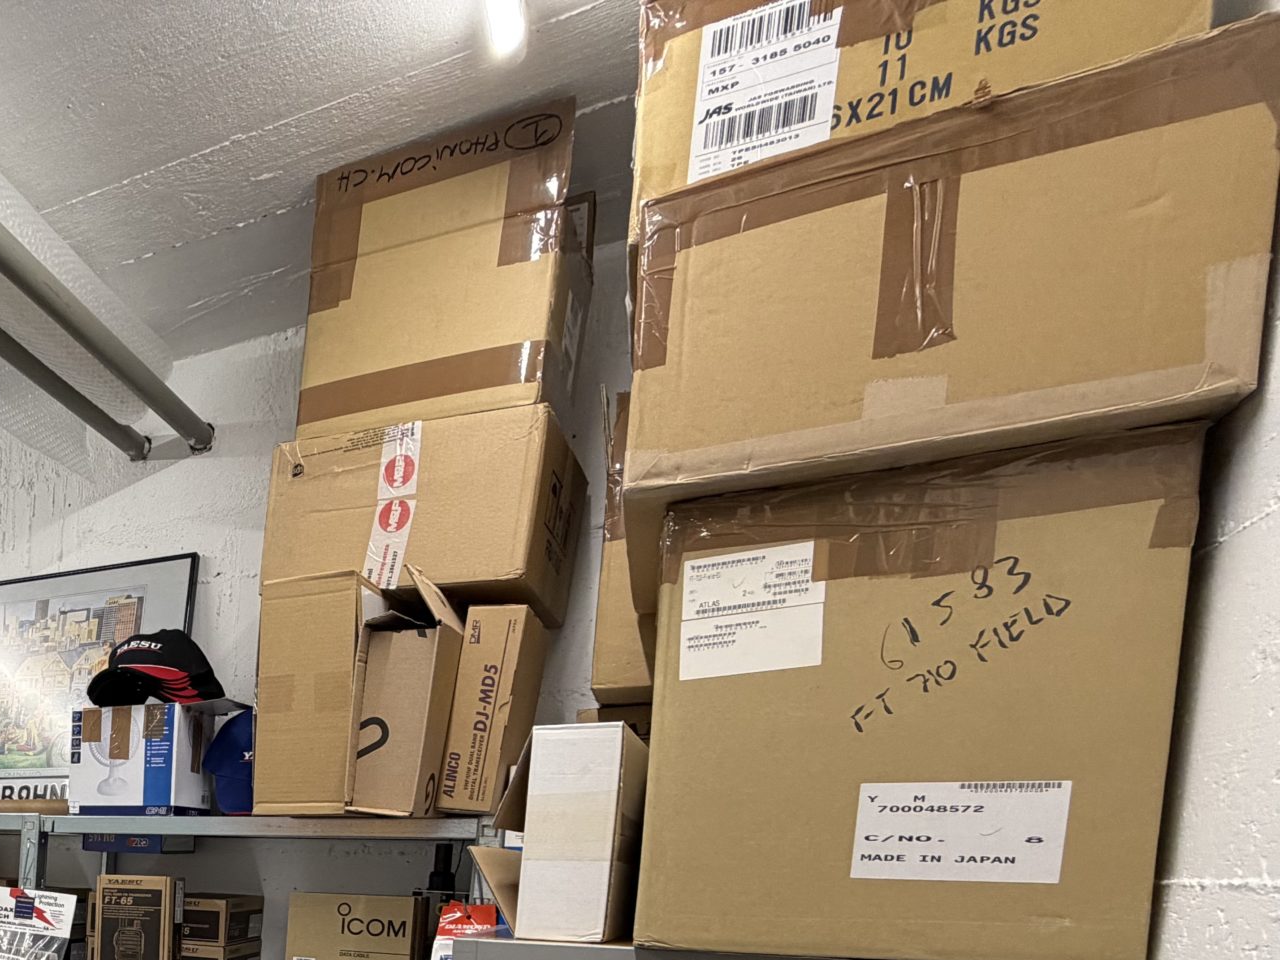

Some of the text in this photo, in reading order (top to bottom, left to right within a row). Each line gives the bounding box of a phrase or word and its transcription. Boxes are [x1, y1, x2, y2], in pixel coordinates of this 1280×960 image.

[974, 13, 1041, 57] KGS
[877, 53, 908, 88] 11
[707, 81, 740, 96] MXP
[698, 102, 734, 125] JAS
[698, 600, 720, 609] ATLAS
[969, 592, 1072, 664] FIELD
[472, 663, 499, 734] DJ-MD5
[442, 751, 461, 799] ALINCO
[867, 795, 926, 803] Y M
[877, 805, 985, 813] 700048572
[1024, 836, 1045, 844] 8
[860, 853, 1016, 865] MADE IN JAPAN
[38, 900, 65, 908] Protection
[104, 897, 133, 905] FT-65
